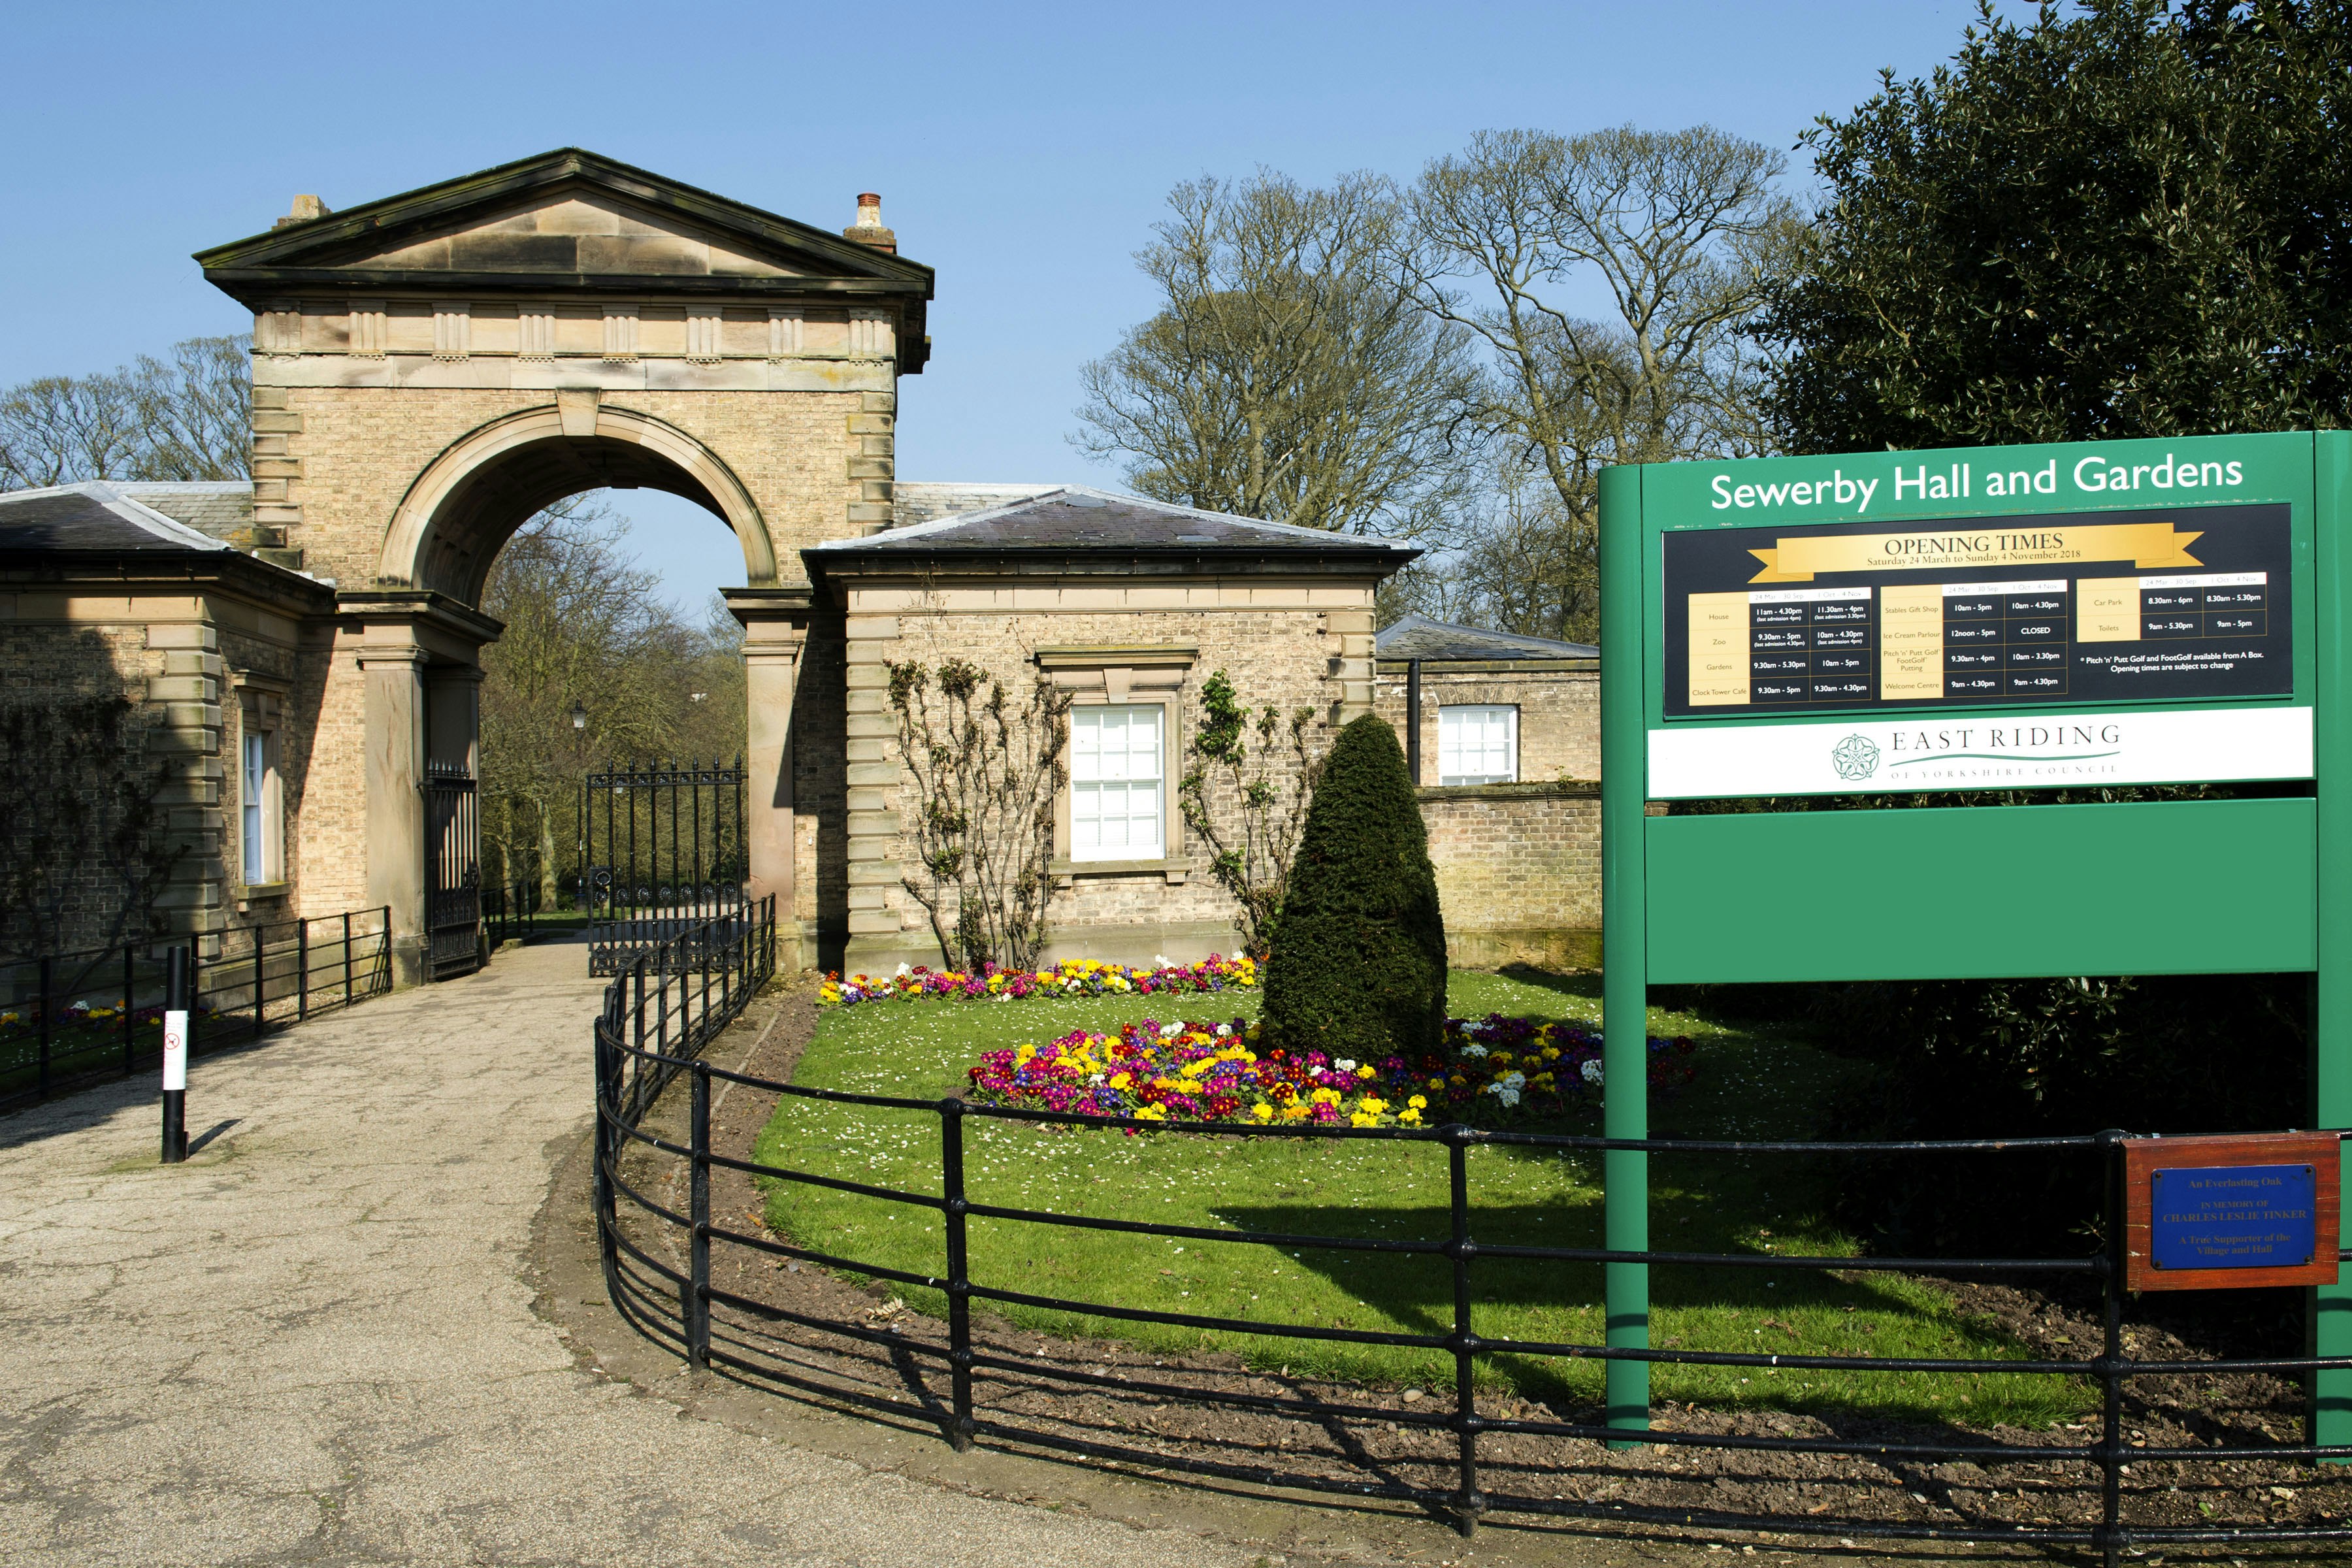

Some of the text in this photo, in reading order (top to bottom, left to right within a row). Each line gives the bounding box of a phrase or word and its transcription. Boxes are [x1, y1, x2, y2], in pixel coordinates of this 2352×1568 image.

[1710, 453, 2243, 513] Sewerby Hall and Gardens
[1885, 533, 2063, 555] OPENING TIMES
[1867, 557, 1906, 567] Saturday
[1909, 556, 1919, 564] 24
[1922, 555, 1951, 564] March
[1965, 553, 1999, 563] Sunday
[2009, 551, 2058, 560] November
[2178, 596, 2193, 605] 6pm
[2236, 594, 2261, 602] 5.30pm
[1922, 606, 1938, 614] Shop
[1977, 604, 1992, 612] 5pm
[2034, 602, 2059, 610] 4.30pm
[1778, 608, 1803, 616] 4.30pm
[2168, 622, 2193, 630] 5.30pm
[2236, 619, 2253, 629] 5pm
[1981, 629, 1995, 638] 5pm
[1980, 655, 1995, 663] 4pm
[2035, 653, 2060, 661] 3.30pm
[2161, 653, 2193, 662] FootGolf
[1782, 661, 1806, 670] 5.30pm
[2110, 664, 2140, 674] Opening
[2174, 663, 2199, 672] subject
[2210, 661, 2234, 670] change
[1970, 680, 1995, 689] 4.30pm
[2034, 678, 2058, 687] 4.30pm
[1842, 684, 1867, 693] 4.30pm
[1892, 724, 2121, 751] EAST RIDING
[1891, 764, 2117, 780] OF YORKSHIRE COUNCIL
[2188, 1177, 2282, 1189] An Everlasting Oak
[2213, 1200, 2255, 1209] MEMORY
[2163, 1210, 2307, 1223] CHARLES LESLIE TINKER
[2188, 1235, 2212, 1245] True
[2213, 1234, 2262, 1245] Supporter
[2264, 1233, 2274, 1242] of
[2276, 1233, 2291, 1241] the
[2196, 1245, 2273, 1256] Village and Hall
